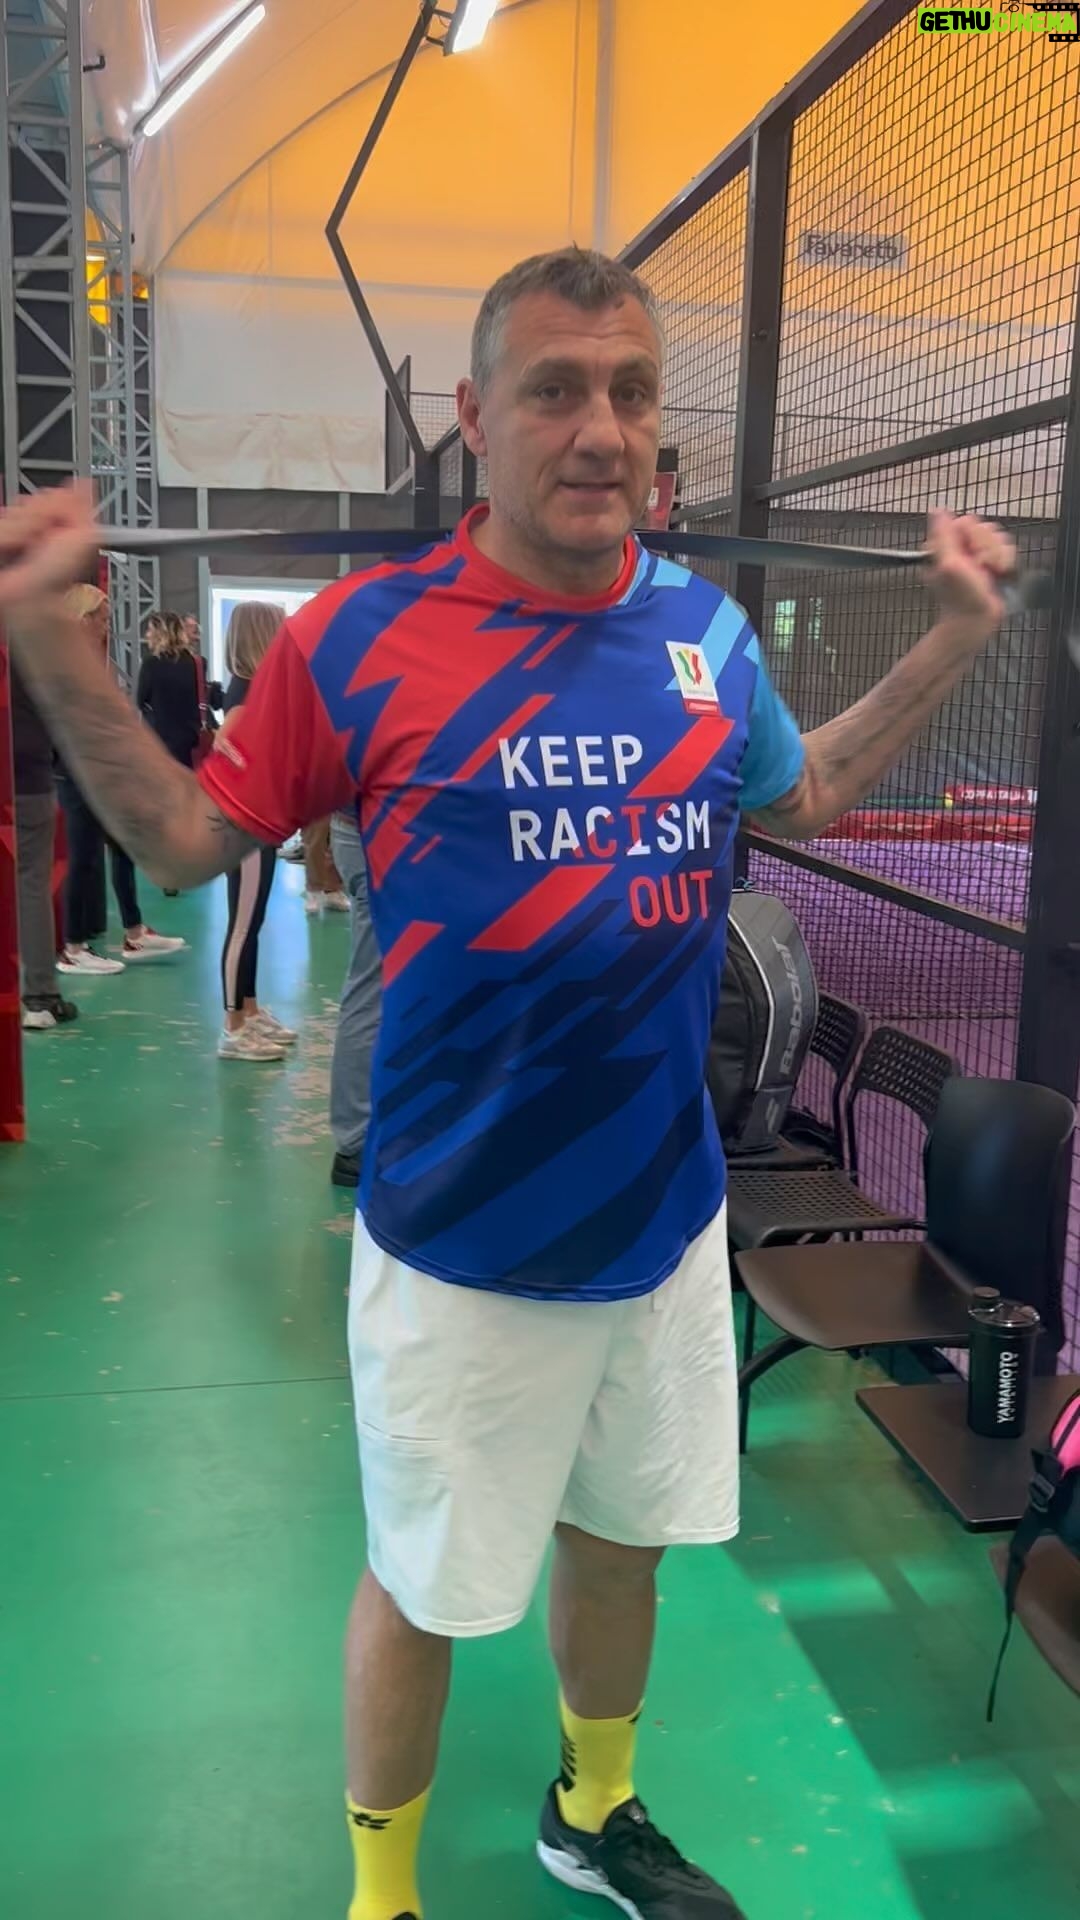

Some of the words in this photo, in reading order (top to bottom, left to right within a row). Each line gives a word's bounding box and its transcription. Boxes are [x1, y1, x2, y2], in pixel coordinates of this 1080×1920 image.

[499, 735, 643, 788] KEEP
[509, 800, 710, 861] RACISM
[629, 870, 713, 928] OUT
[997, 1352, 1014, 1424] YAMAMOTO
